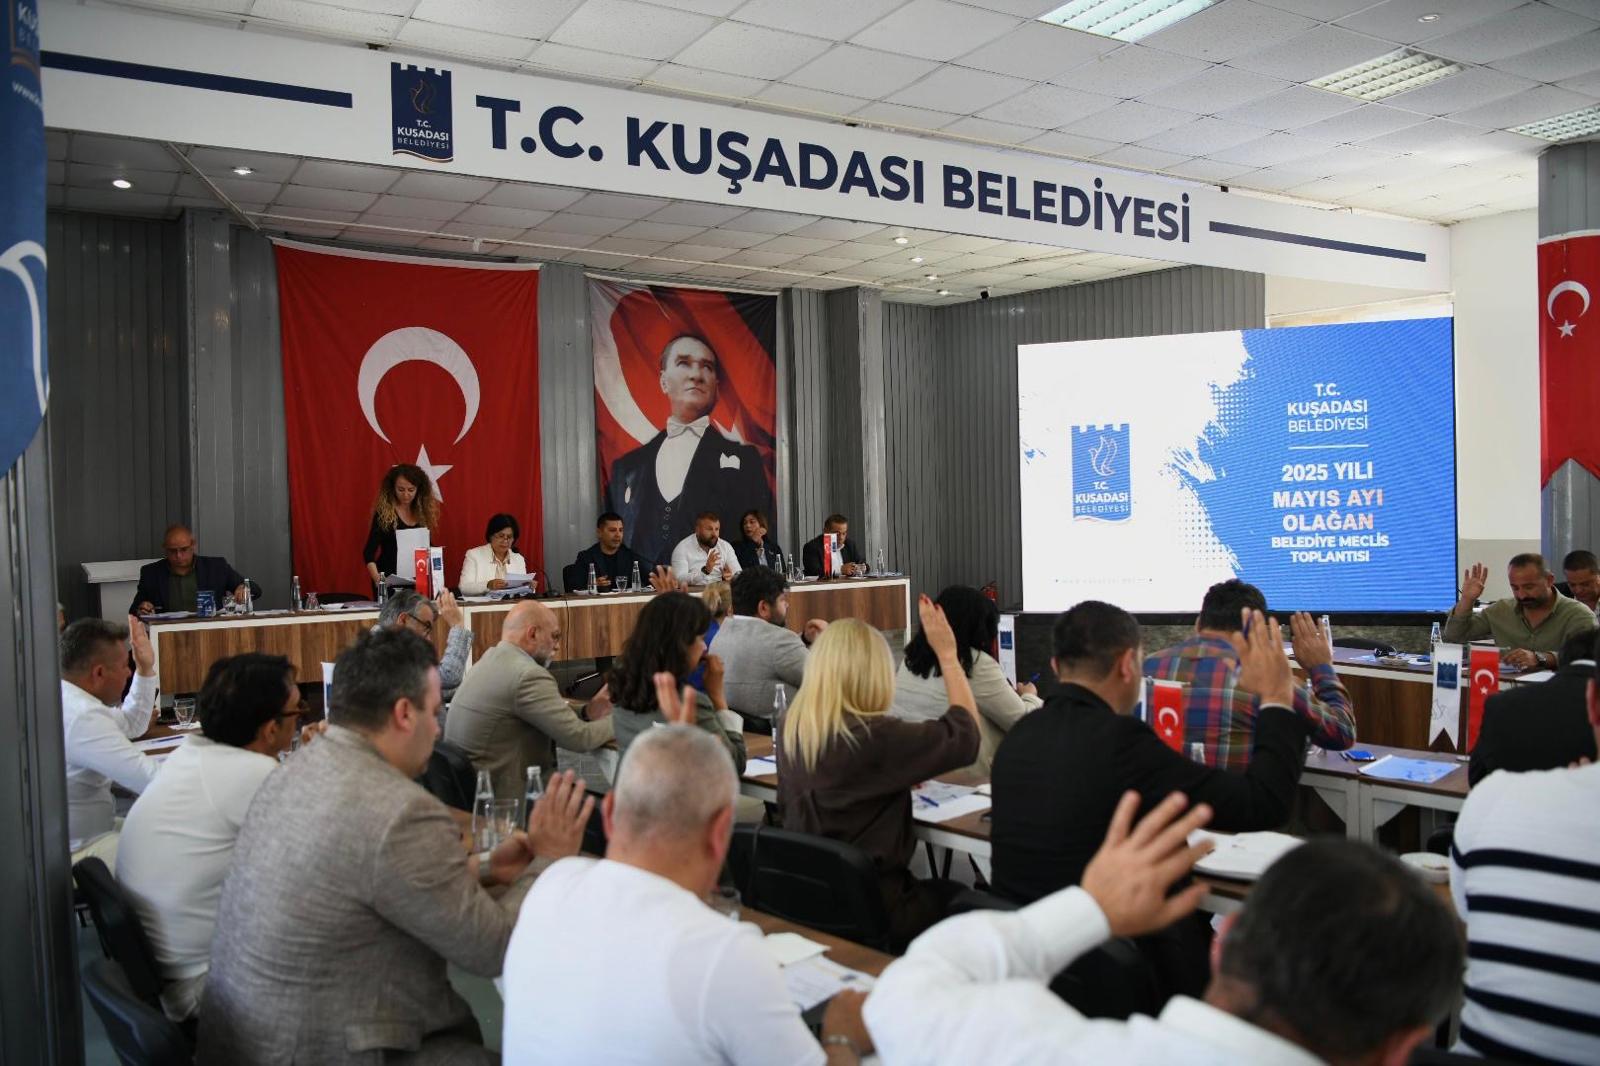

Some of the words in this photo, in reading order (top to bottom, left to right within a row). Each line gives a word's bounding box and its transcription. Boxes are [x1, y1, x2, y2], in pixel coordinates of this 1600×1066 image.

[415, 119, 432, 128] T.C.
[475, 94, 604, 162] T.C.
[626, 116, 924, 204] KUŞADASI
[942, 164, 1190, 243] BELEDİYESİ
[1312, 382, 1341, 397] T.C.
[1287, 399, 1368, 418] KUŞADASI
[1288, 415, 1368, 432] BELEDİYESİ
[1281, 463, 1329, 482] 2025
[1333, 461, 1374, 480] YILI
[1272, 489, 1341, 508] MAYIS
[1346, 488, 1384, 507] AYI
[1282, 509, 1374, 532] OLAĞAN
[1271, 532, 1337, 548] BELEDİYE
[1339, 531, 1390, 547] MECLİS
[1290, 550, 1371, 563] TOPLANTISI
